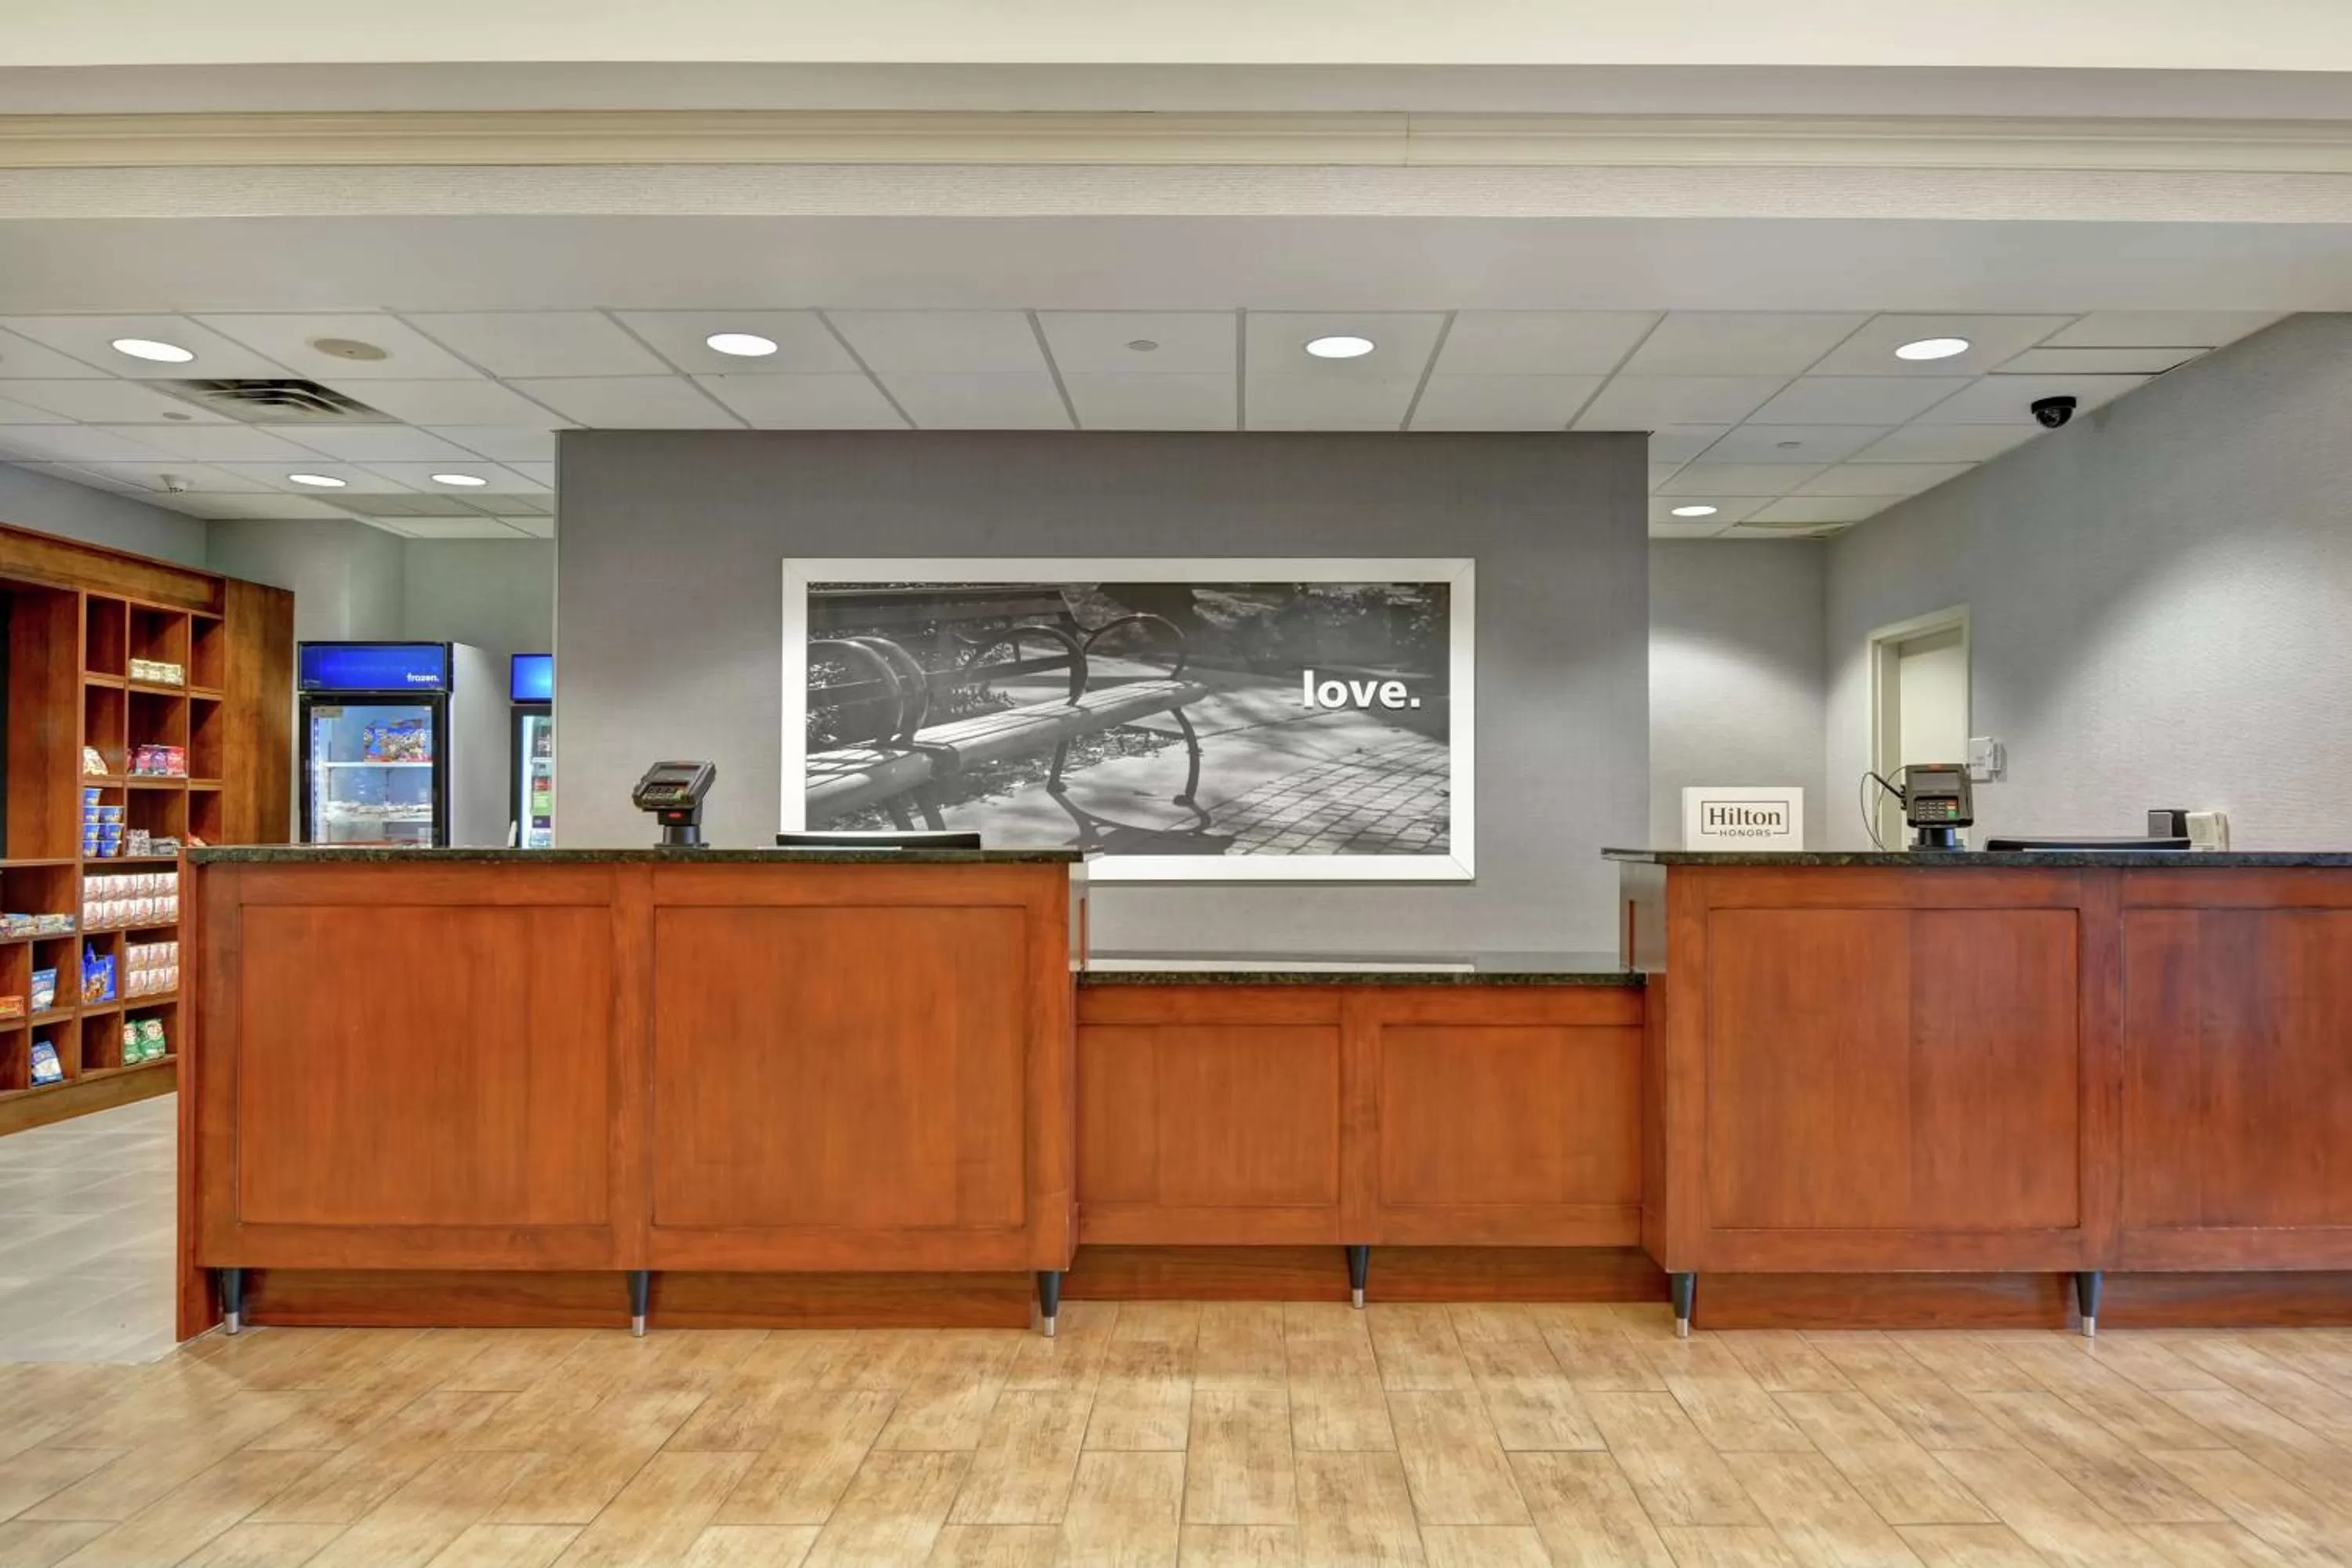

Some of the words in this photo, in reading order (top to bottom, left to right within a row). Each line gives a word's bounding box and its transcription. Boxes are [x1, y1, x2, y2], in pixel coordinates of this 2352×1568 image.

[406, 672, 440, 681] frozen.
[1303, 669, 1421, 709] love.
[1709, 807, 1782, 826] Hilton
[1719, 829, 1771, 837] HONORS
